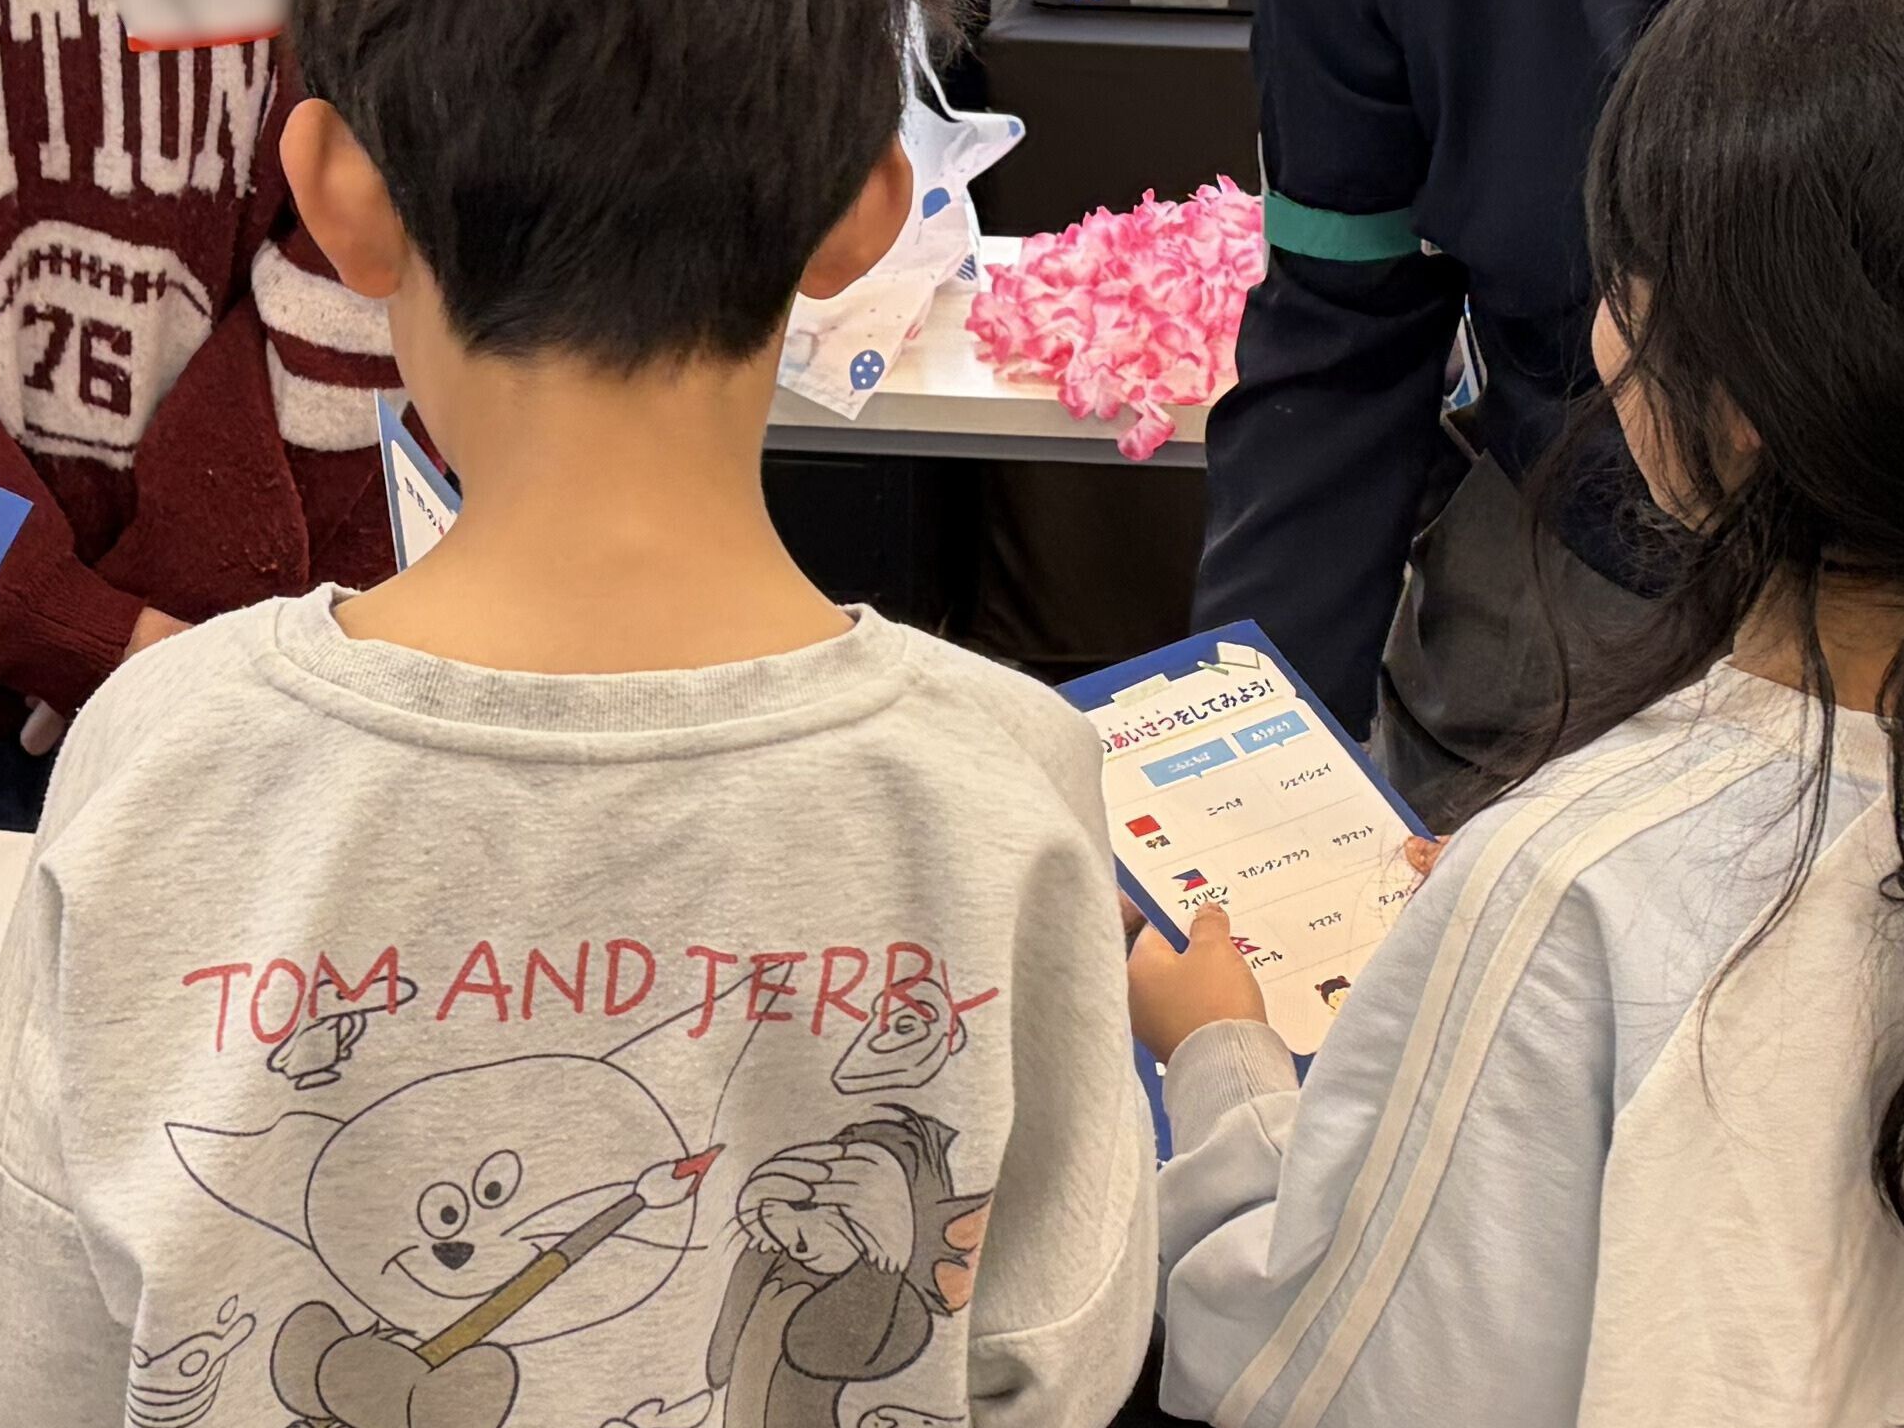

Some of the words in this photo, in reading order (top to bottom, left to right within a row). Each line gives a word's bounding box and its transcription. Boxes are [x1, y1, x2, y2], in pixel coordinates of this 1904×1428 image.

[21, 302, 133, 417] 76
[183, 946, 402, 1052] TOM
[435, 938, 658, 1026] AND
[683, 941, 1000, 1058] JERRY
